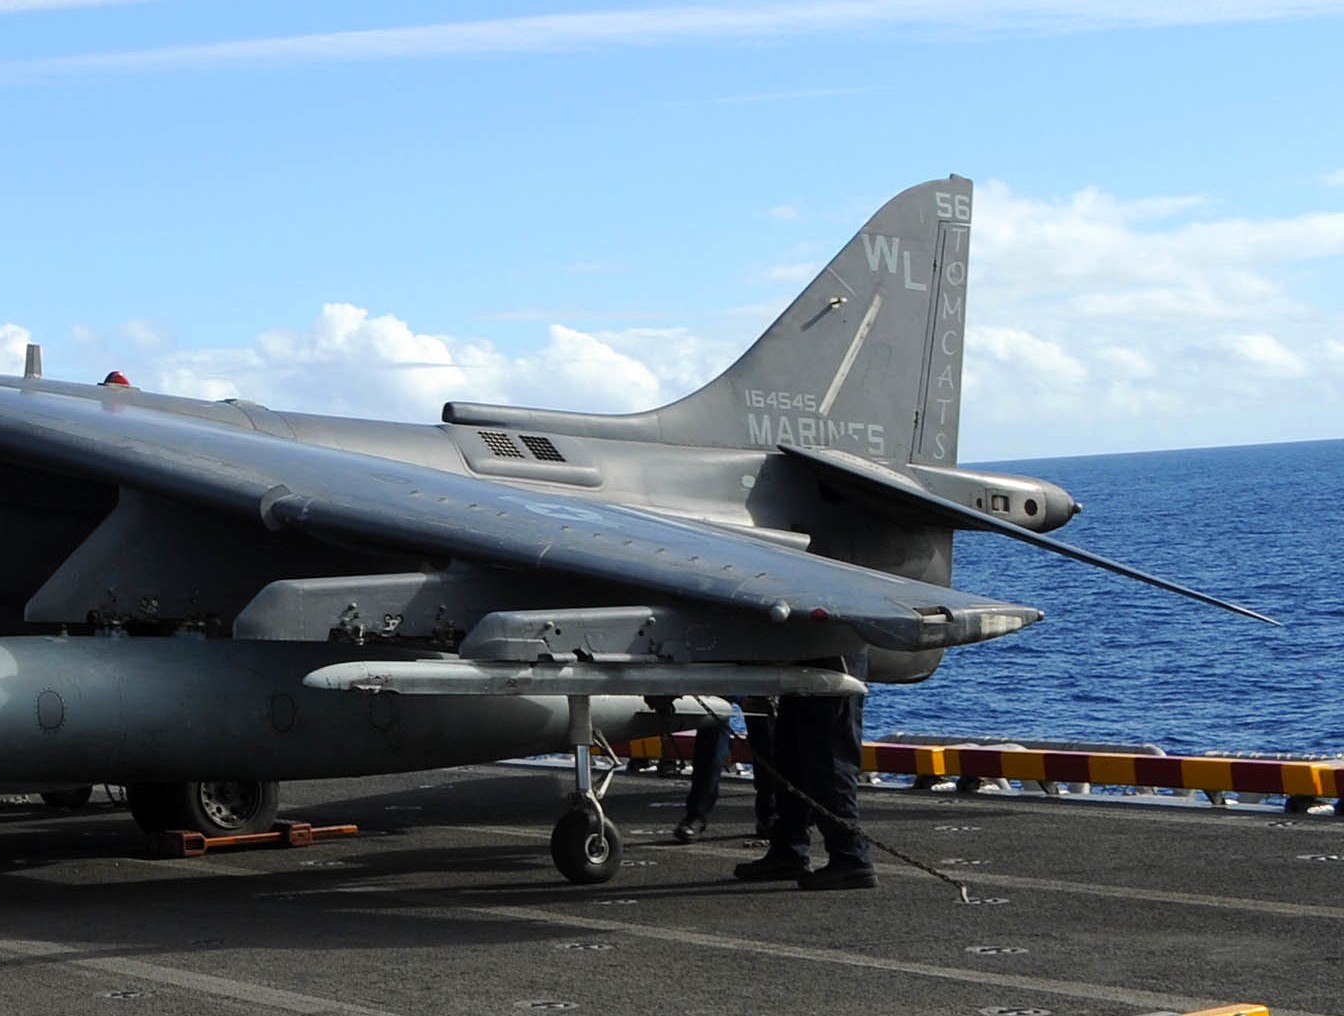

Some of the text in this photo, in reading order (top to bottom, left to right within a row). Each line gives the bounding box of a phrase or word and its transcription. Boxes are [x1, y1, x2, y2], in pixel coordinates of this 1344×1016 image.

[936, 192, 970, 220] 56
[861, 234, 927, 292] WL
[932, 227, 969, 460] TOMCATS
[745, 389, 817, 412] 164545
